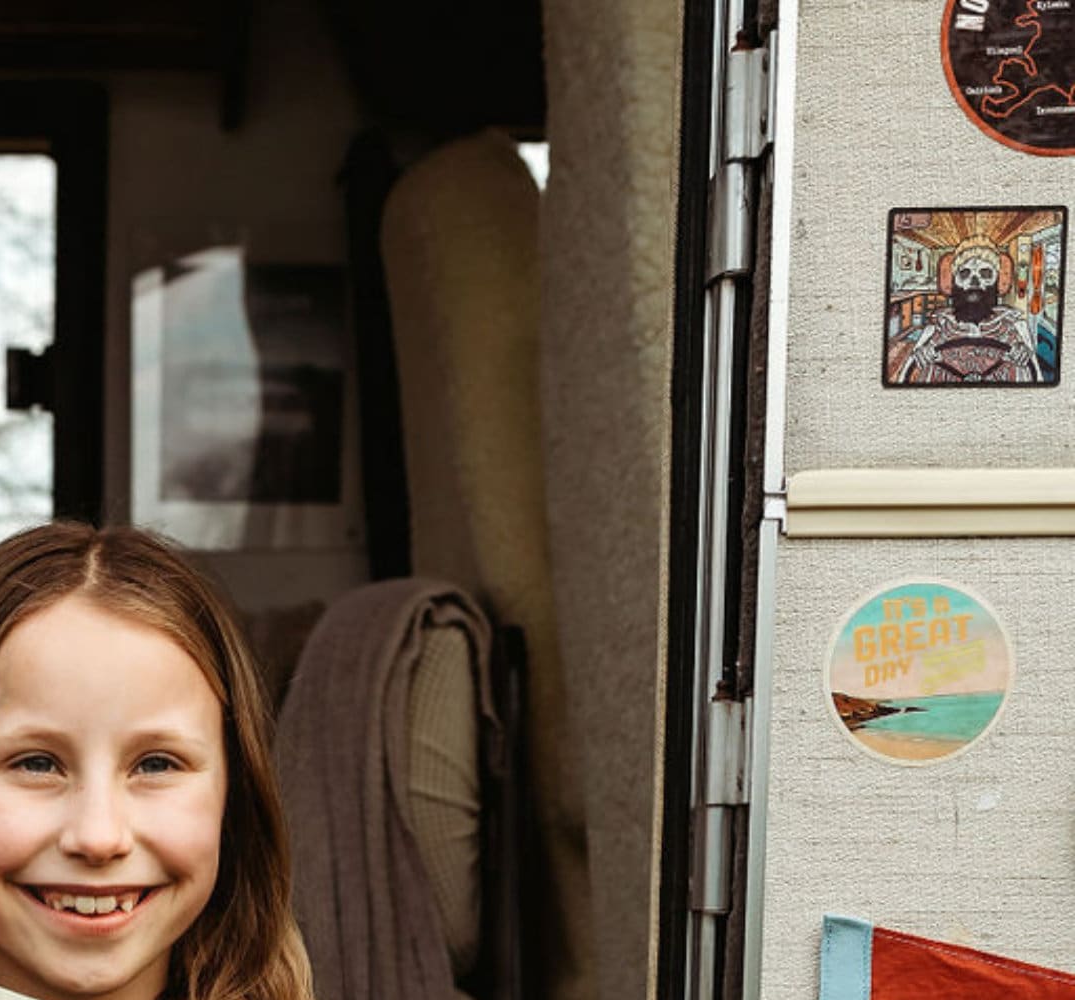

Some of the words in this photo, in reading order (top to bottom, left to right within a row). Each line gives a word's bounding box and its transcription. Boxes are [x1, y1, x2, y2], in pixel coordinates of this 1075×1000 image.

[883, 597, 926, 620] IT'S
[933, 597, 950, 615] A
[853, 615, 973, 662] GREAT
[864, 656, 913, 688] DAY
